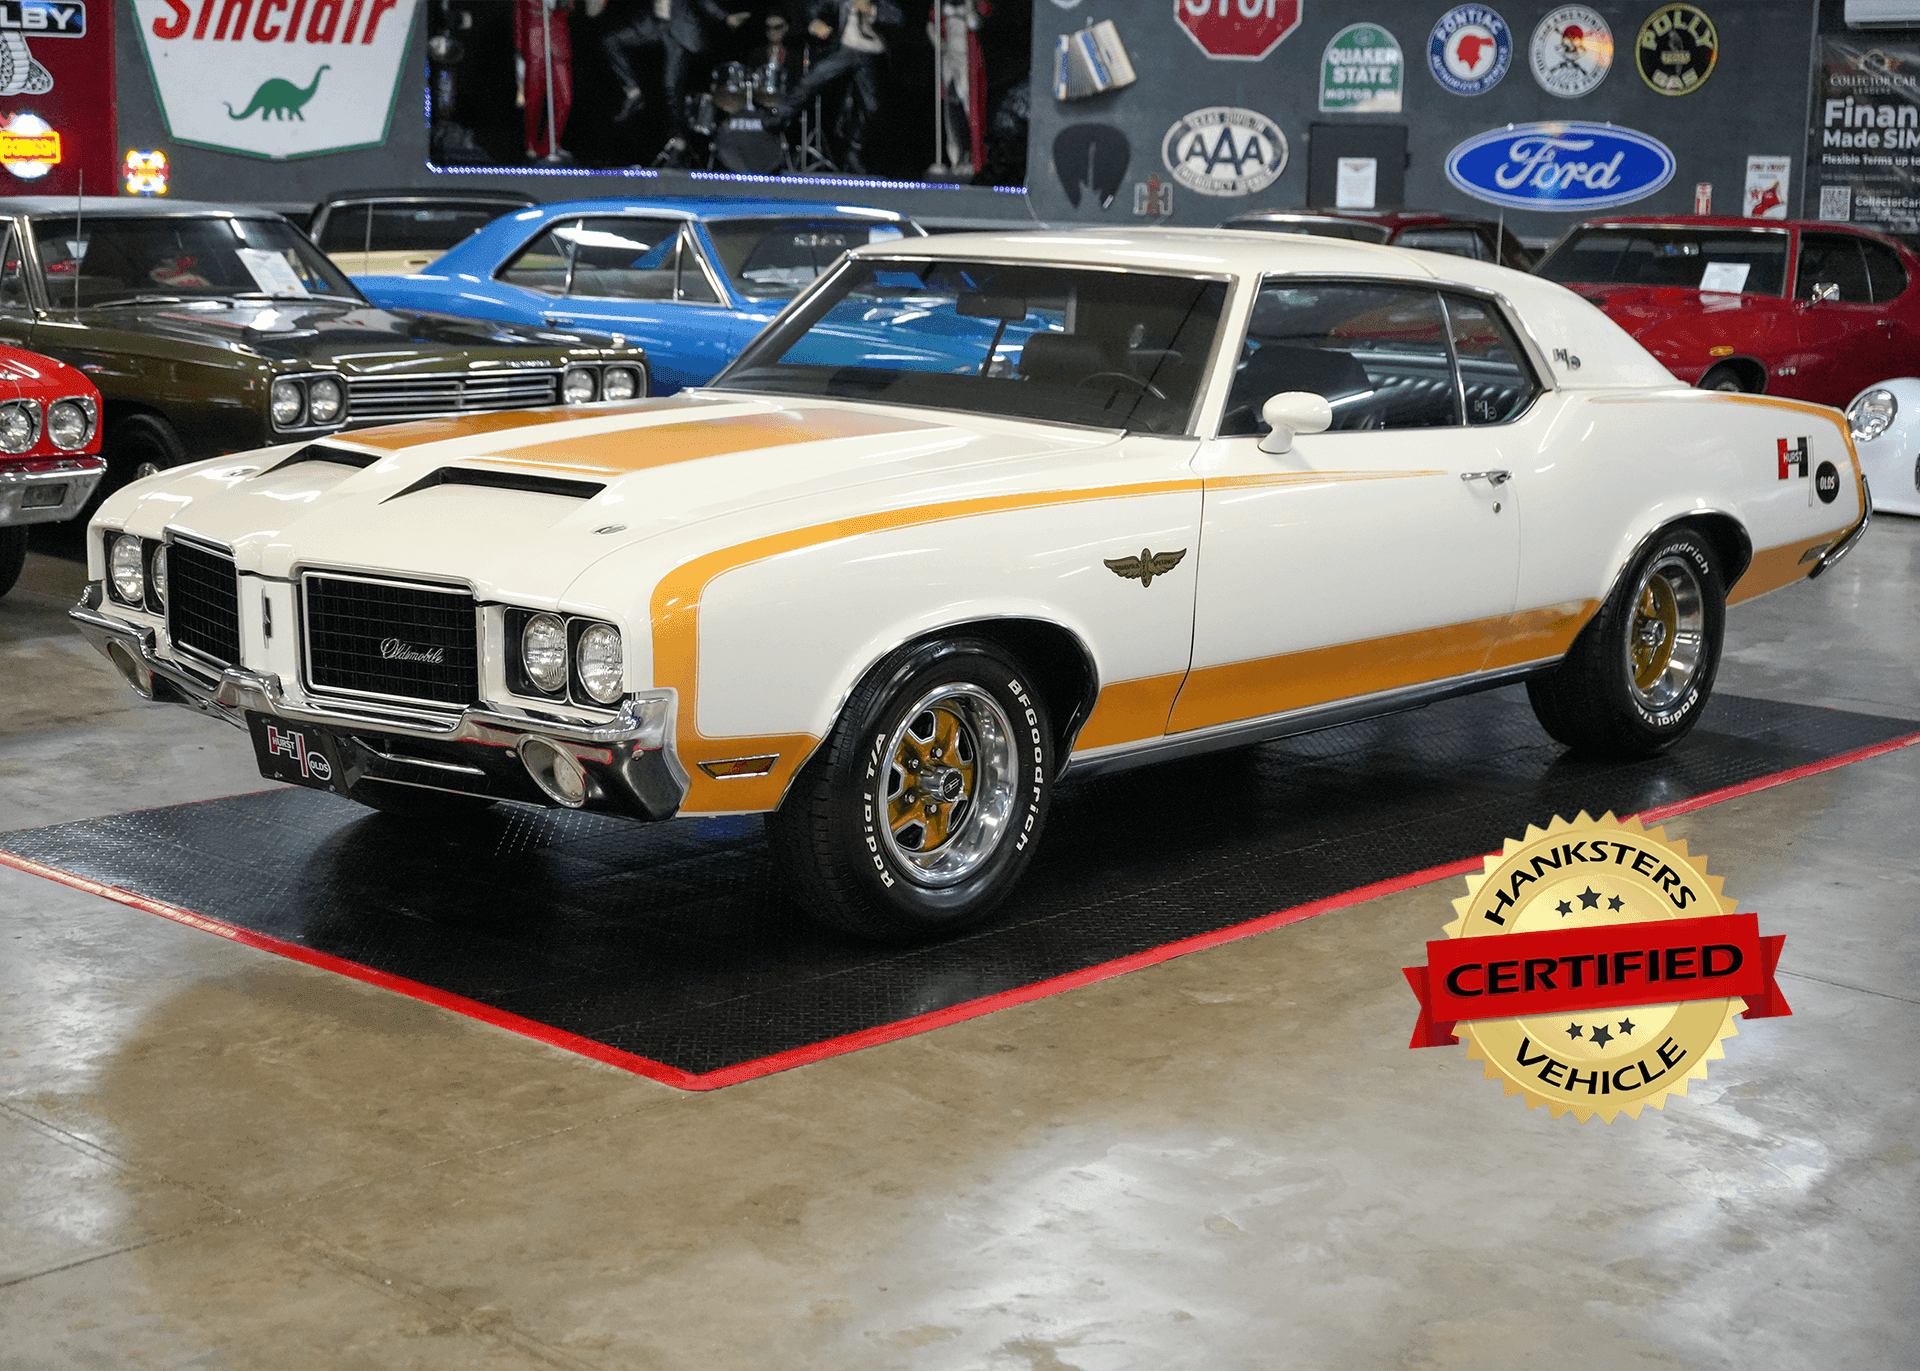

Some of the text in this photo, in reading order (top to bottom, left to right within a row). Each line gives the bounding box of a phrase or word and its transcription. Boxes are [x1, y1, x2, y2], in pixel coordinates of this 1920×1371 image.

[152, 0, 398, 45] Sinclair
[1435, 9, 1503, 41] PONTIAC
[1642, 12, 1713, 51] POLLY
[1328, 48, 1399, 65] QUAKER
[1333, 66, 1393, 84] STATE
[1830, 73, 1917, 88] COLLECTOR CAR
[1825, 95, 1919, 128] Finan
[1185, 126, 1264, 175] AAA
[1823, 128, 1920, 149] Made SIM
[1495, 136, 1625, 190] Ford
[1822, 153, 1861, 165] Flexible
[1863, 154, 1893, 166] Terms
[1895, 156, 1908, 167] up
[1783, 450, 1803, 463] HURST
[1820, 476, 1835, 490] OLDS
[380, 637, 444, 664] Oldsmobile
[1637, 688, 1699, 727] Radial T/A
[272, 736, 295, 750] HURST
[309, 760, 329, 773] OLDS
[1008, 679, 1044, 851] BFGoodrich
[863, 733, 895, 888] Radial T/A
